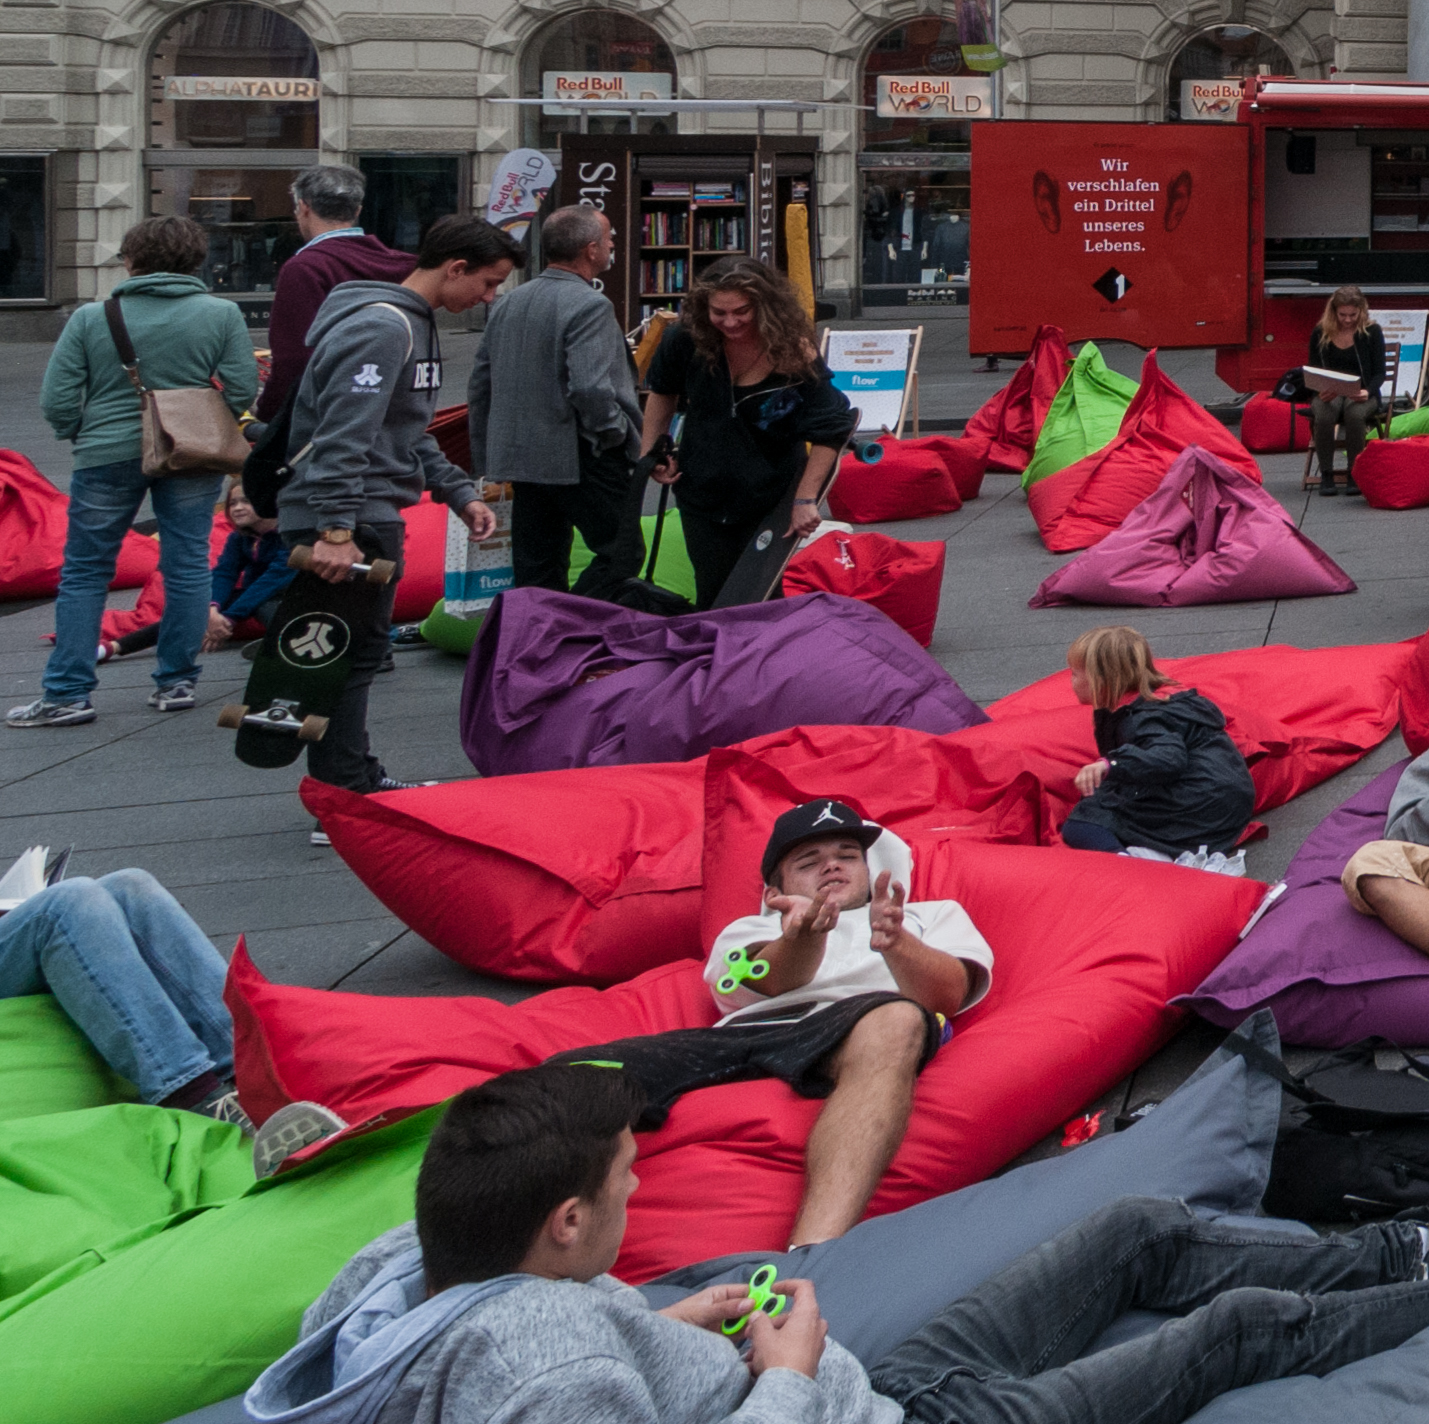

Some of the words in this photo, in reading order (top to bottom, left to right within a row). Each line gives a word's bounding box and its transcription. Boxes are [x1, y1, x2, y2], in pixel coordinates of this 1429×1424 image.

[557, 77, 588, 90] Red
[592, 77, 623, 90] Bull
[890, 81, 919, 94] Red
[921, 81, 950, 94] Bull
[1193, 85, 1218, 98] Red
[1222, 85, 1243, 98] Bul
[888, 95, 982, 113] WORLD
[1101, 159, 1129, 171] Wir
[1067, 178, 1160, 192] verschlafen
[491, 187, 510, 213] Red
[502, 173, 520, 193] Bull
[1074, 199, 1099, 212] ein
[1104, 199, 1155, 212] Drittel
[1083, 221, 1145, 232] unseres
[1085, 239, 1146, 252] Lebens.
[852, 375, 879, 386] flow
[480, 576, 513, 589] flow
